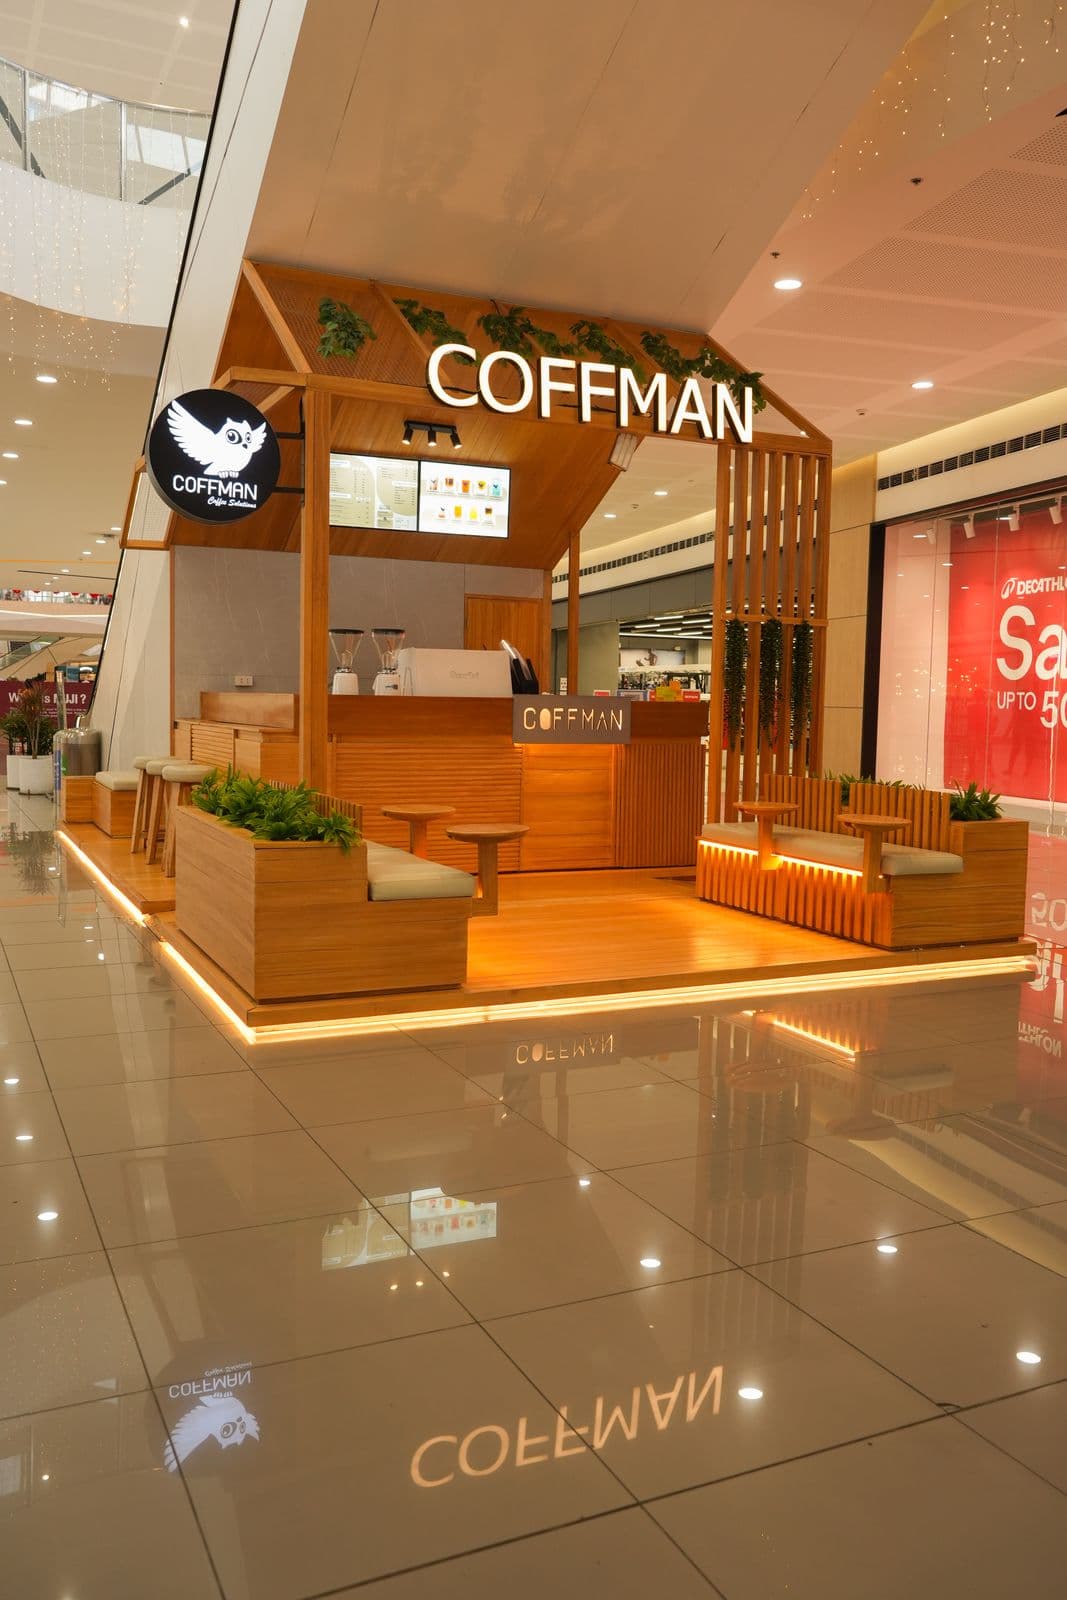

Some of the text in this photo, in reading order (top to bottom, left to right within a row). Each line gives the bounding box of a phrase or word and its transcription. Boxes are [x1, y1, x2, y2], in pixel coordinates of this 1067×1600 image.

[427, 343, 753, 443] COFFMAN
[172, 474, 258, 500] COFFMAN
[1016, 576, 1067, 595] DECATHL
[997, 691, 1015, 710] UP
[1017, 691, 1037, 710] TO
[523, 707, 623, 731] COFFMAN
